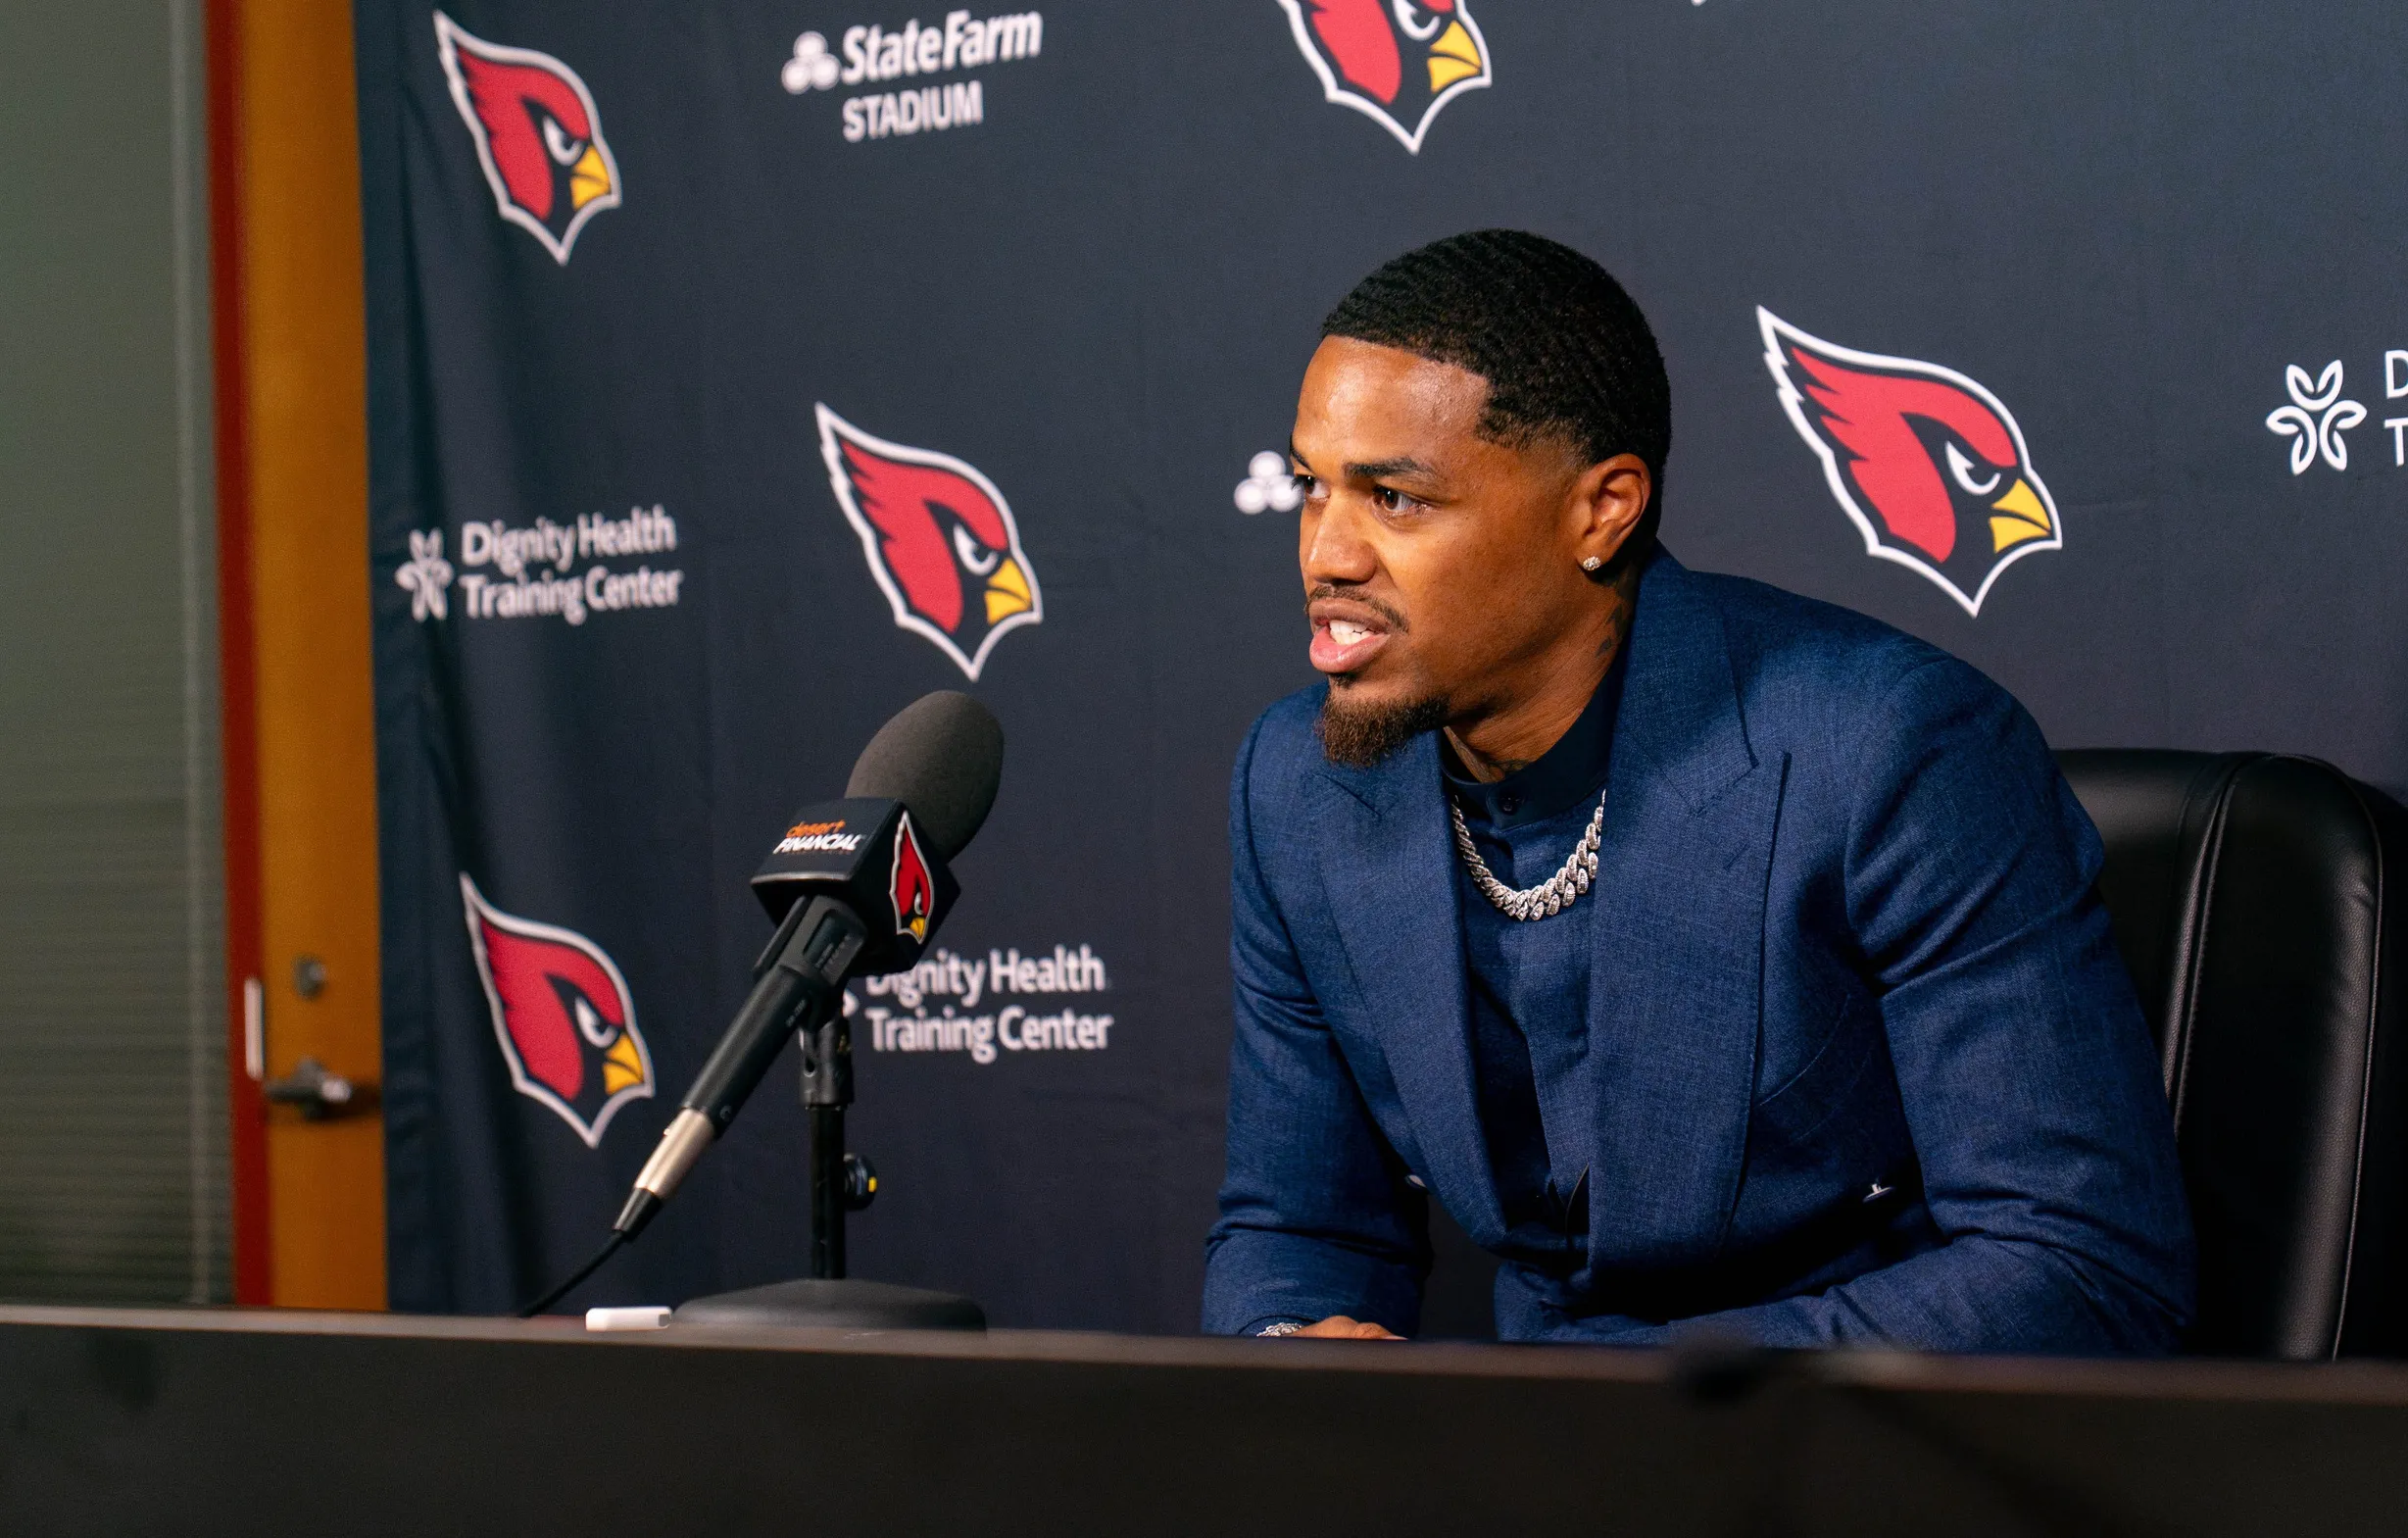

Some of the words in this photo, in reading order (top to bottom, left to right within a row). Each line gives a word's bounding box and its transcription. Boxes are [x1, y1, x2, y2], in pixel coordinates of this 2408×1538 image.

[842, 79, 984, 143] STADIUM
[462, 516, 576, 576] Dignity
[576, 504, 678, 558] Health
[458, 568, 587, 625] Training
[585, 565, 684, 612] Center
[772, 833, 864, 855] FINANCIAL
[989, 942, 1106, 993] Health
[863, 1005, 998, 1065] Training
[997, 1004, 1115, 1051] Center
